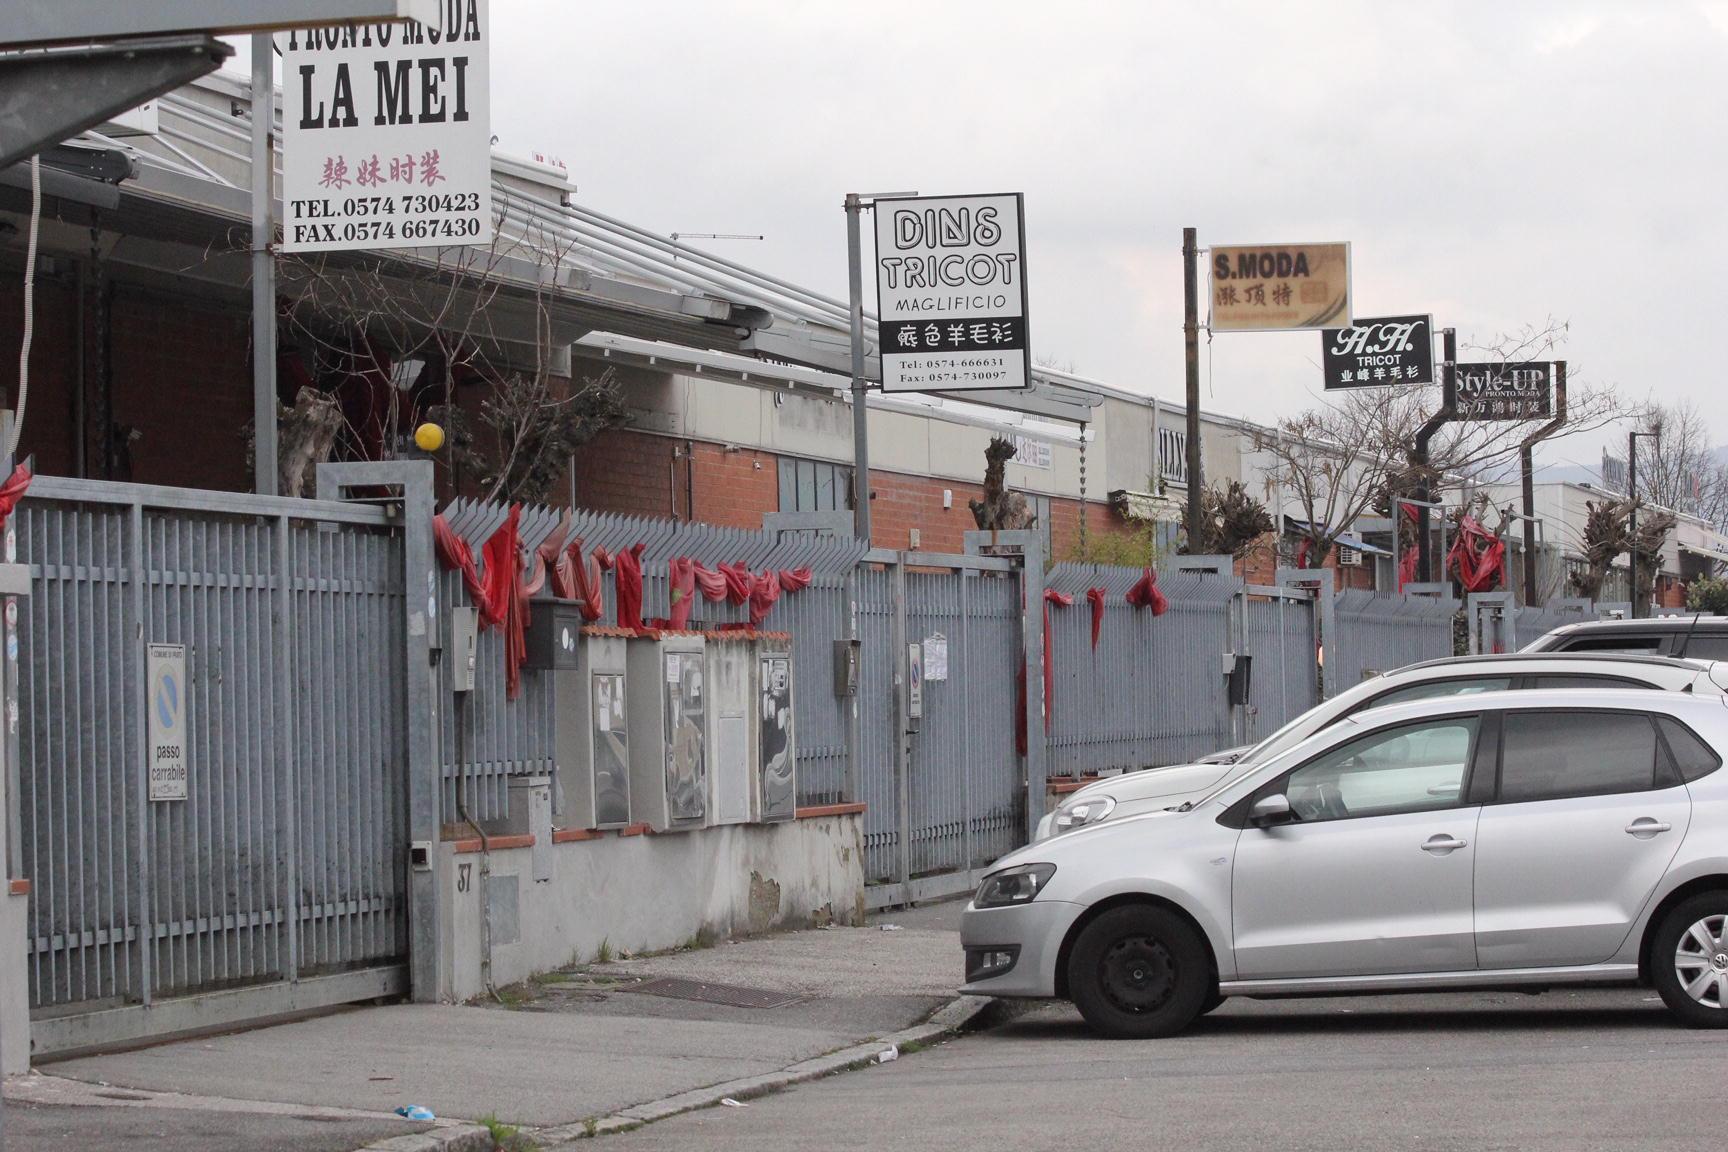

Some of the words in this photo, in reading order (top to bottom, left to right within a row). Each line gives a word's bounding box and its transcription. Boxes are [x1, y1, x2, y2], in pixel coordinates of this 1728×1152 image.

[299, 63, 359, 130] LA
[374, 56, 469, 126] MEI
[318, 149, 447, 191] 辣妹时装
[291, 197, 396, 219] TEL.0574
[401, 193, 481, 214] 730423
[294, 221, 397, 244] FAX.0574
[401, 217, 481, 239] 667430
[894, 206, 1002, 250] DINS
[881, 253, 1018, 289] TRICOT
[1215, 252, 1310, 280] S.MODA
[896, 294, 1007, 312] MAGLIFICIO
[899, 360, 923, 369] Tel:
[926, 358, 1004, 369] 0574-666631
[1356, 354, 1402, 367] TRICOT
[900, 373, 925, 383] Fax:
[929, 371, 1008, 382] 0574-730097
[1485, 390, 1516, 398] PRONTO
[157, 745, 180, 763] passo
[152, 764, 185, 782] carrabile
[457, 863, 473, 893] 37
